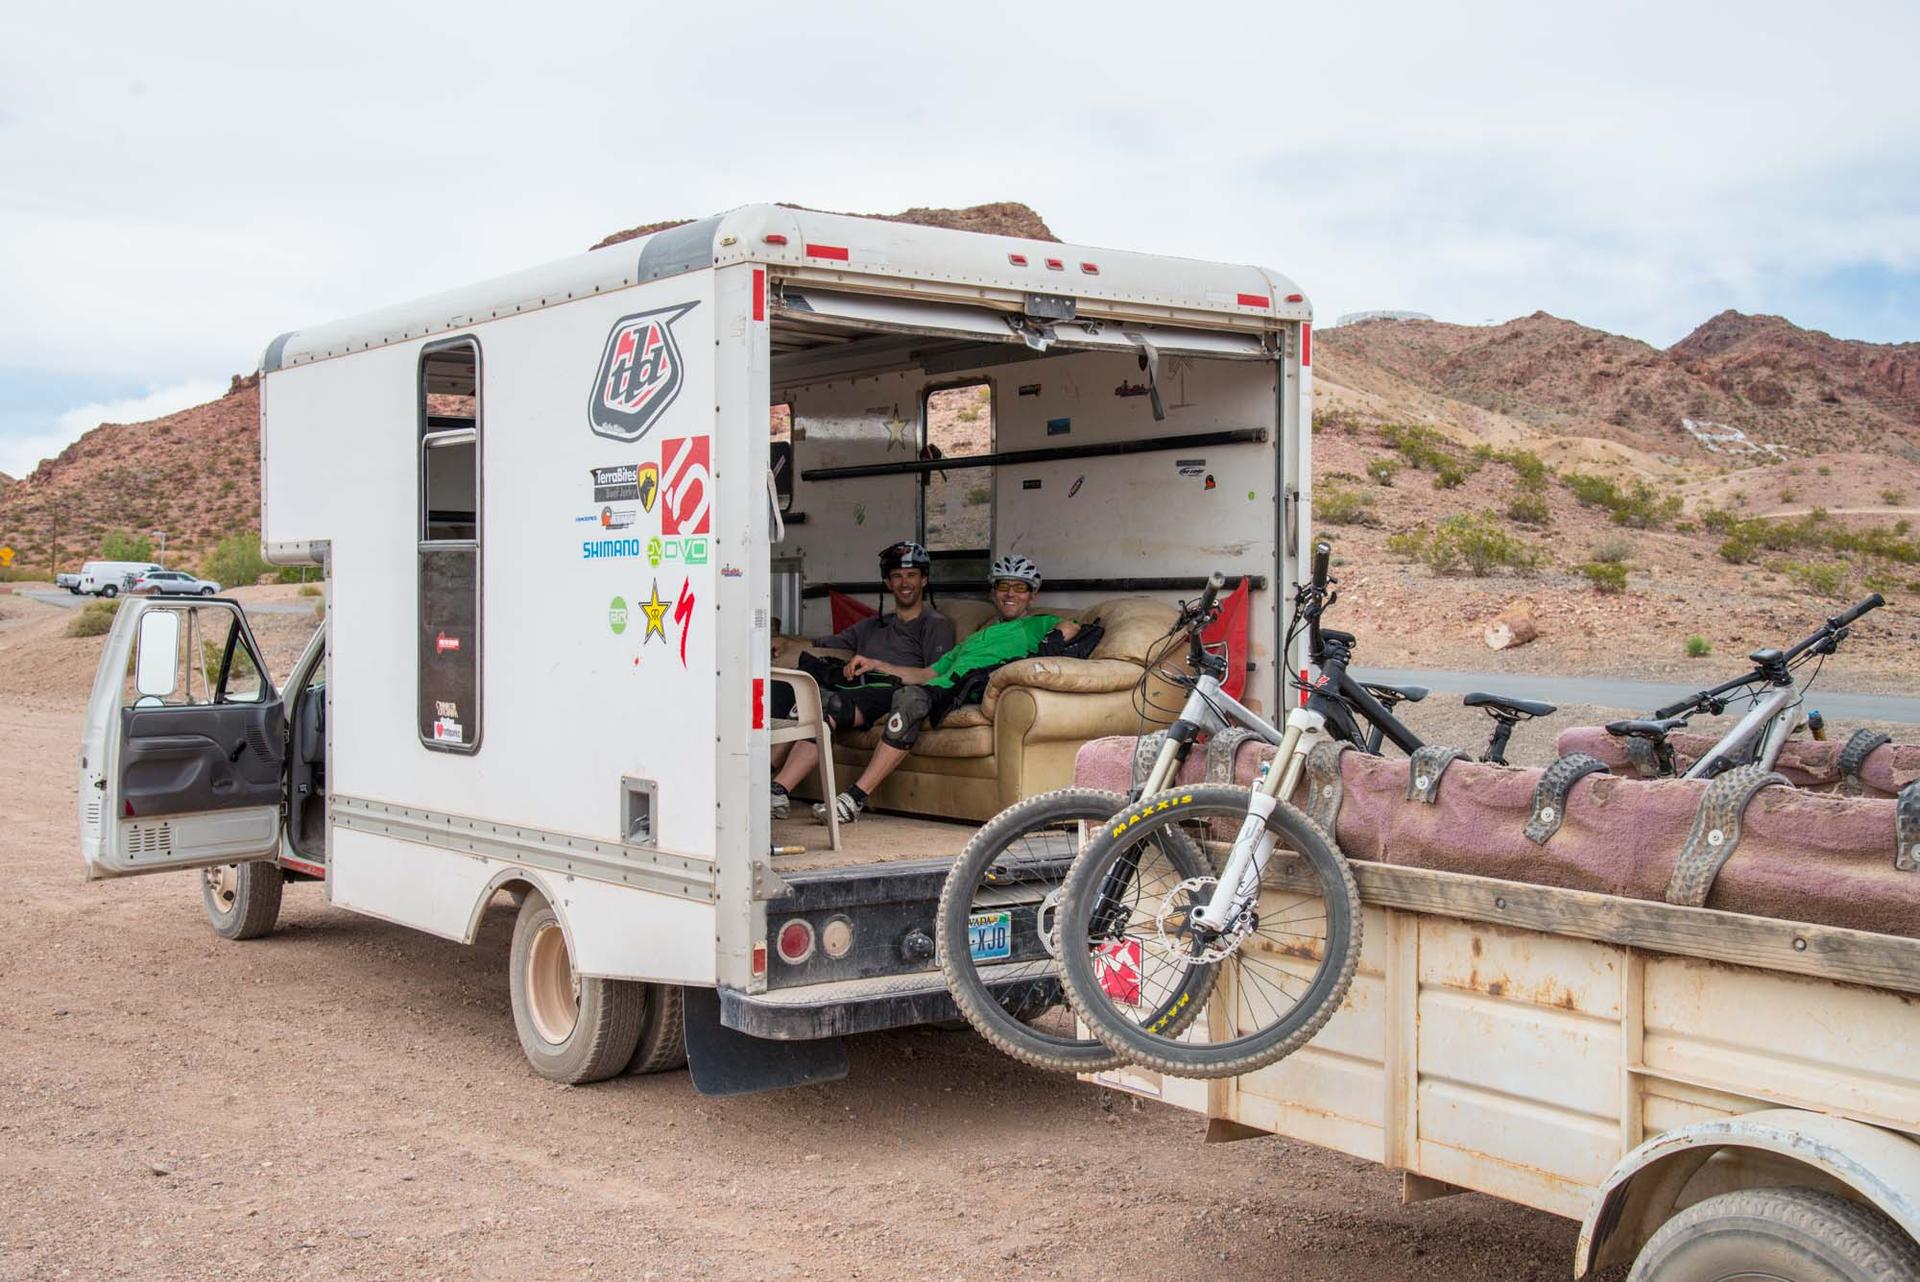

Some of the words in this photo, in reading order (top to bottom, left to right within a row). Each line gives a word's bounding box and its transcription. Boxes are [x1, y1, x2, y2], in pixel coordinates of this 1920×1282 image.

[596, 467, 637, 485] TerraBites
[583, 538, 640, 559] SHIMANO
[1113, 794, 1193, 838] MAXXIS
[969, 915, 992, 927] VADA
